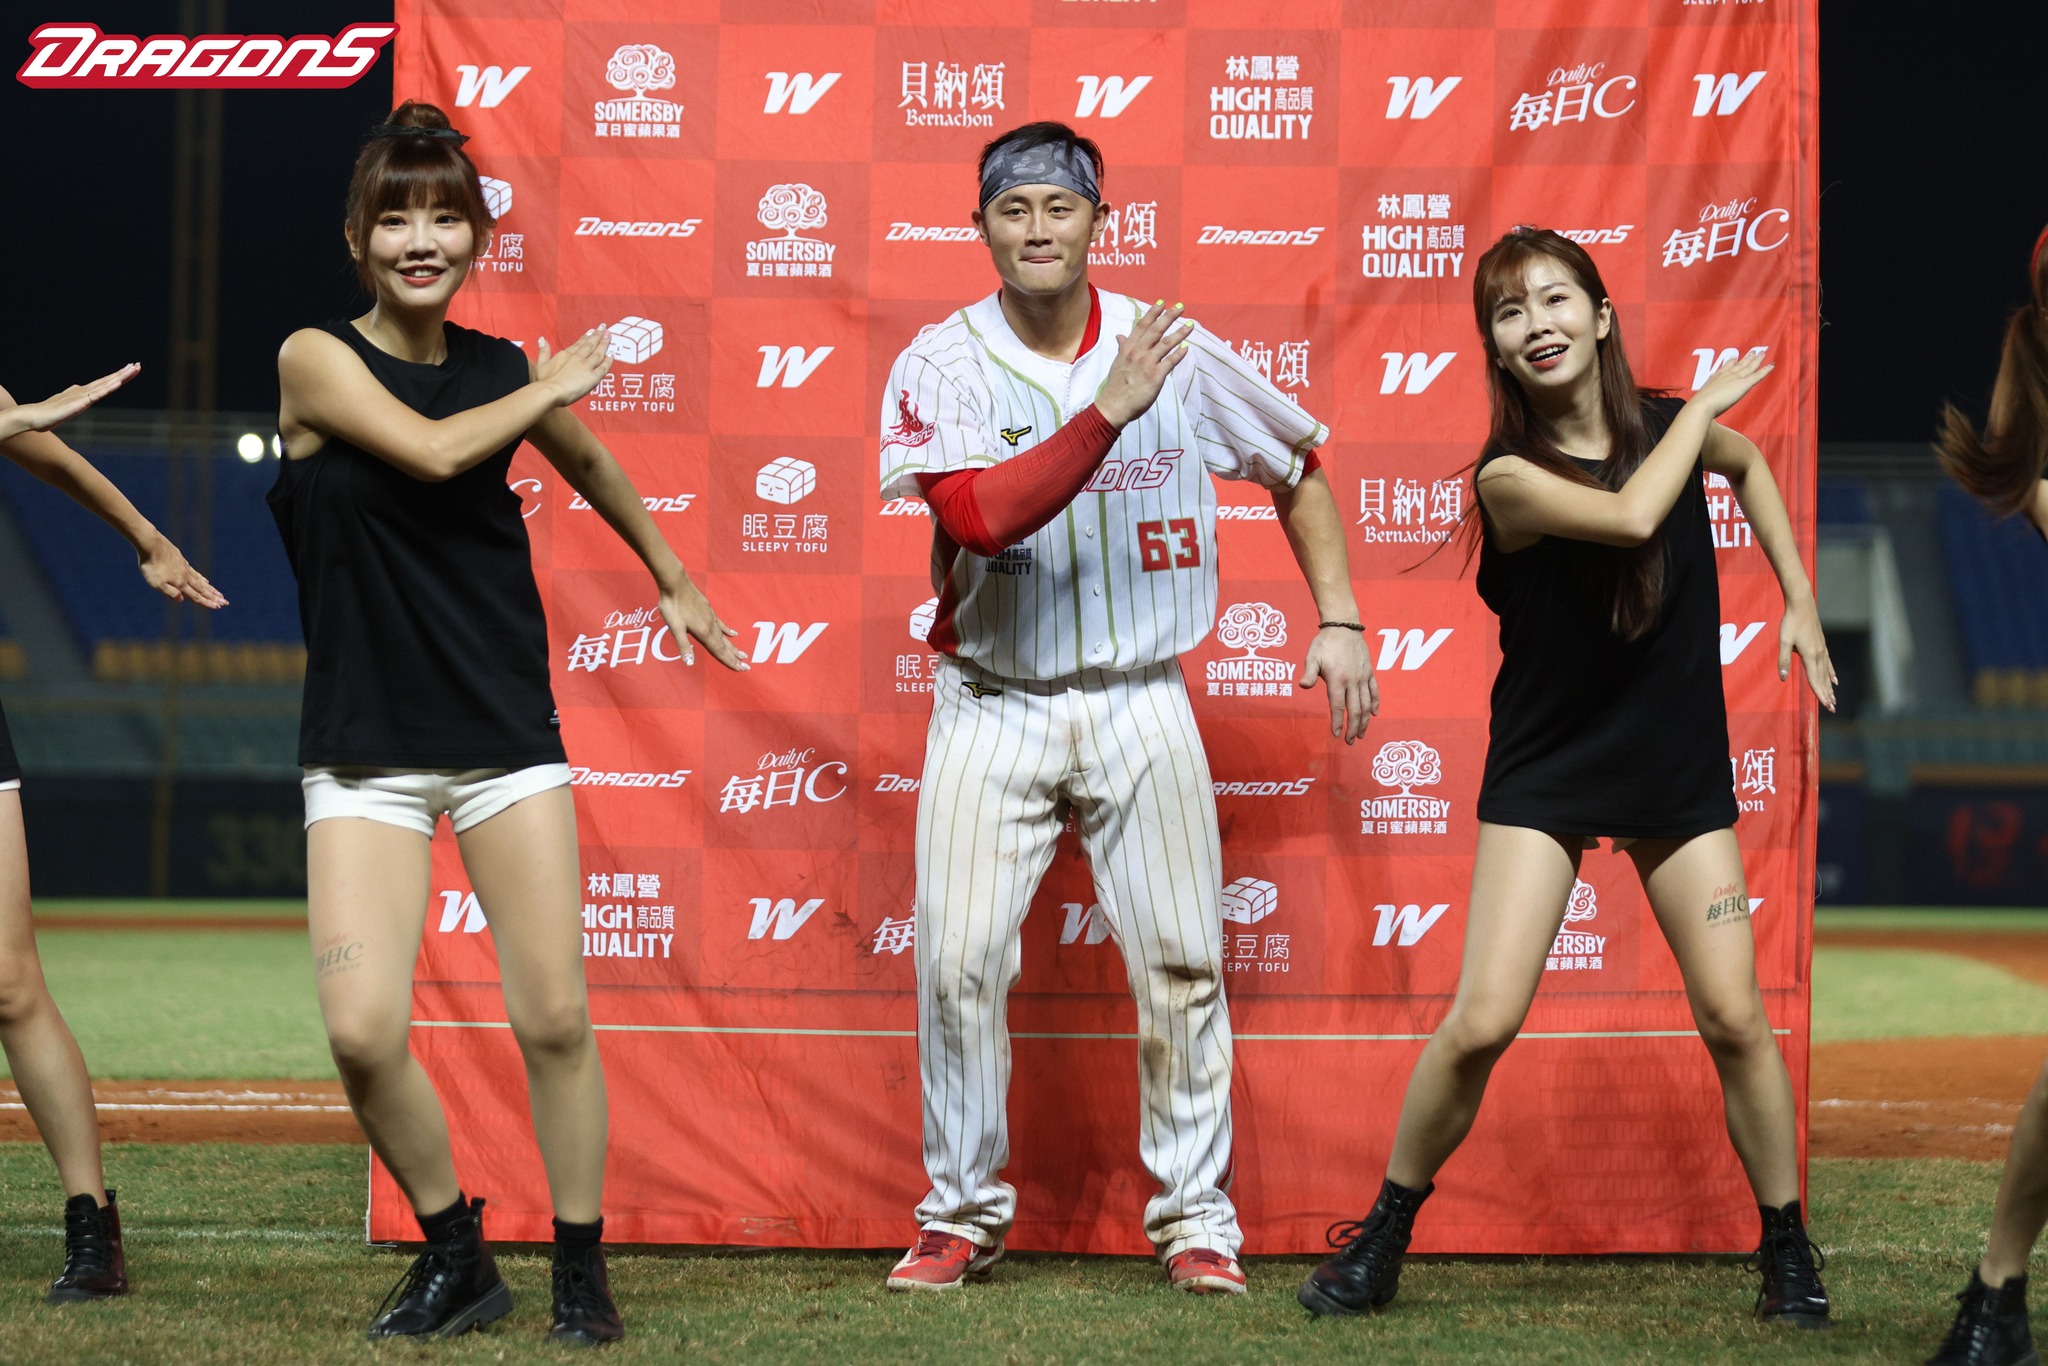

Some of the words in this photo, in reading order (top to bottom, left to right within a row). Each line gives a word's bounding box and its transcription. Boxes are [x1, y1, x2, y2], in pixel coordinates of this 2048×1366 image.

[1226, 56, 1299, 80] 林鳳營
[456, 65, 531, 107] W
[764, 72, 841, 114] W
[898, 62, 1005, 110] 貝納頌
[1075, 76, 1152, 117] W
[1386, 77, 1462, 119] W
[1691, 71, 1766, 117] W
[1210, 87, 1271, 111] HIGH
[1275, 87, 1313, 110] 高品質
[595, 102, 683, 123] SOMERSBY
[905, 109, 994, 127] Bernachon
[595, 123, 681, 139] 夏日蜜蘋果酒
[1211, 114, 1312, 139] QUALITY
[1378, 194, 1451, 218] 林鳳營
[574, 217, 703, 238] DRAGONS
[885, 222, 980, 242] DRAGO
[1198, 226, 1325, 245] DRAGONS
[1362, 226, 1422, 250] HIGH
[1427, 225, 1464, 249] 高品質
[746, 241, 836, 263] SOMERSBY
[1088, 246, 1145, 266] nachon
[492, 262, 522, 272] TOFU
[747, 263, 832, 276] 夏日蜜蘋果酒
[1363, 253, 1463, 277] QUALITY
[757, 346, 835, 388] W
[1380, 352, 1457, 394] W
[590, 401, 636, 411] SLEEPY
[643, 402, 674, 412] TOFU
[1356, 478, 1464, 526] 貝納頌
[743, 514, 829, 540] 眠豆腐
[1365, 525, 1451, 544] Bernachon
[743, 542, 788, 551] SLEEPY
[796, 543, 827, 552] TOFU
[1137, 517, 1201, 573] 63
[751, 622, 829, 664] W
[1376, 629, 1453, 670] W
[1206, 661, 1295, 683] SOMERSBY
[896, 683, 933, 692] SLEEP
[1207, 683, 1292, 696] 夏日蜜蘋果酒
[1212, 778, 1316, 796] RAGONS
[1361, 799, 1451, 820] SOMERSBY
[1362, 821, 1447, 834] 夏日蜜蘋果酒
[588, 873, 660, 898] 林鳳營
[637, 905, 674, 929] 高品質
[748, 898, 824, 939] W
[1373, 904, 1450, 946] W
[1549, 935, 1606, 955] ERSBY
[1257, 963, 1289, 972] TOFU
[1546, 957, 1602, 970] 蜜蘋果酒
